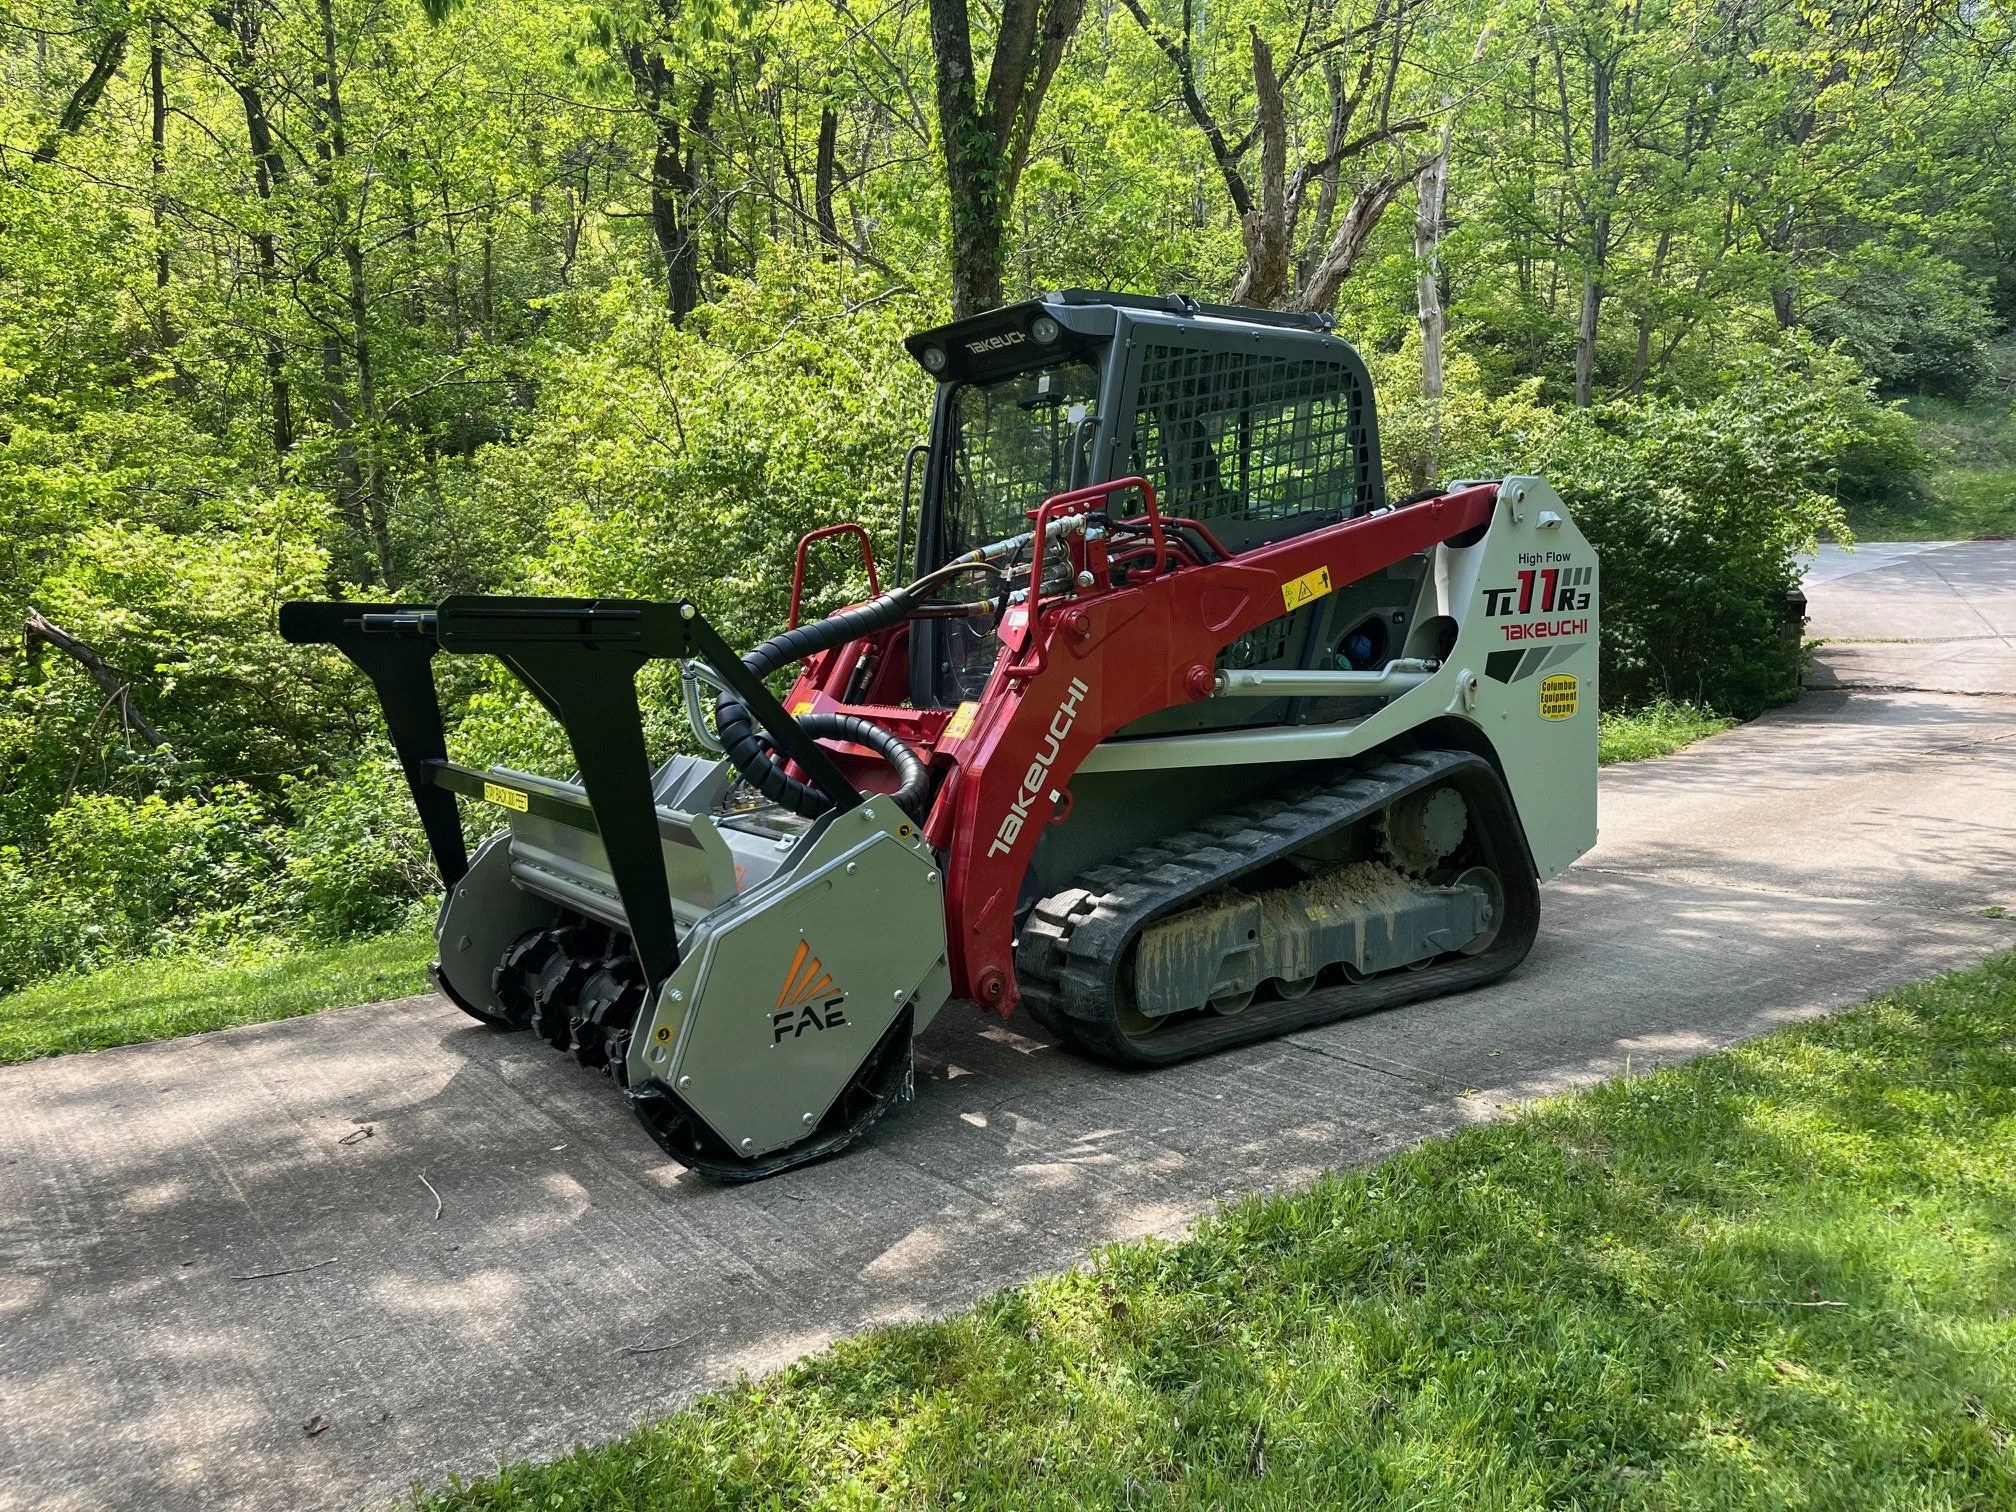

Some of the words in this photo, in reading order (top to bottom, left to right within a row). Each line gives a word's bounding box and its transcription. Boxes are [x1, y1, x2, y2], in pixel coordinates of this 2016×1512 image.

[965, 331, 1026, 354] TAKEUCH
[1518, 553, 1543, 567] High
[1546, 552, 1571, 563] Flow
[1482, 568, 1591, 617] TL11R3
[1542, 680, 1576, 692] Columbus
[1541, 691, 1577, 703] Equipment
[1542, 703, 1575, 714] Company
[515, 793, 527, 810] FEET
[774, 997, 846, 1044] FAE
